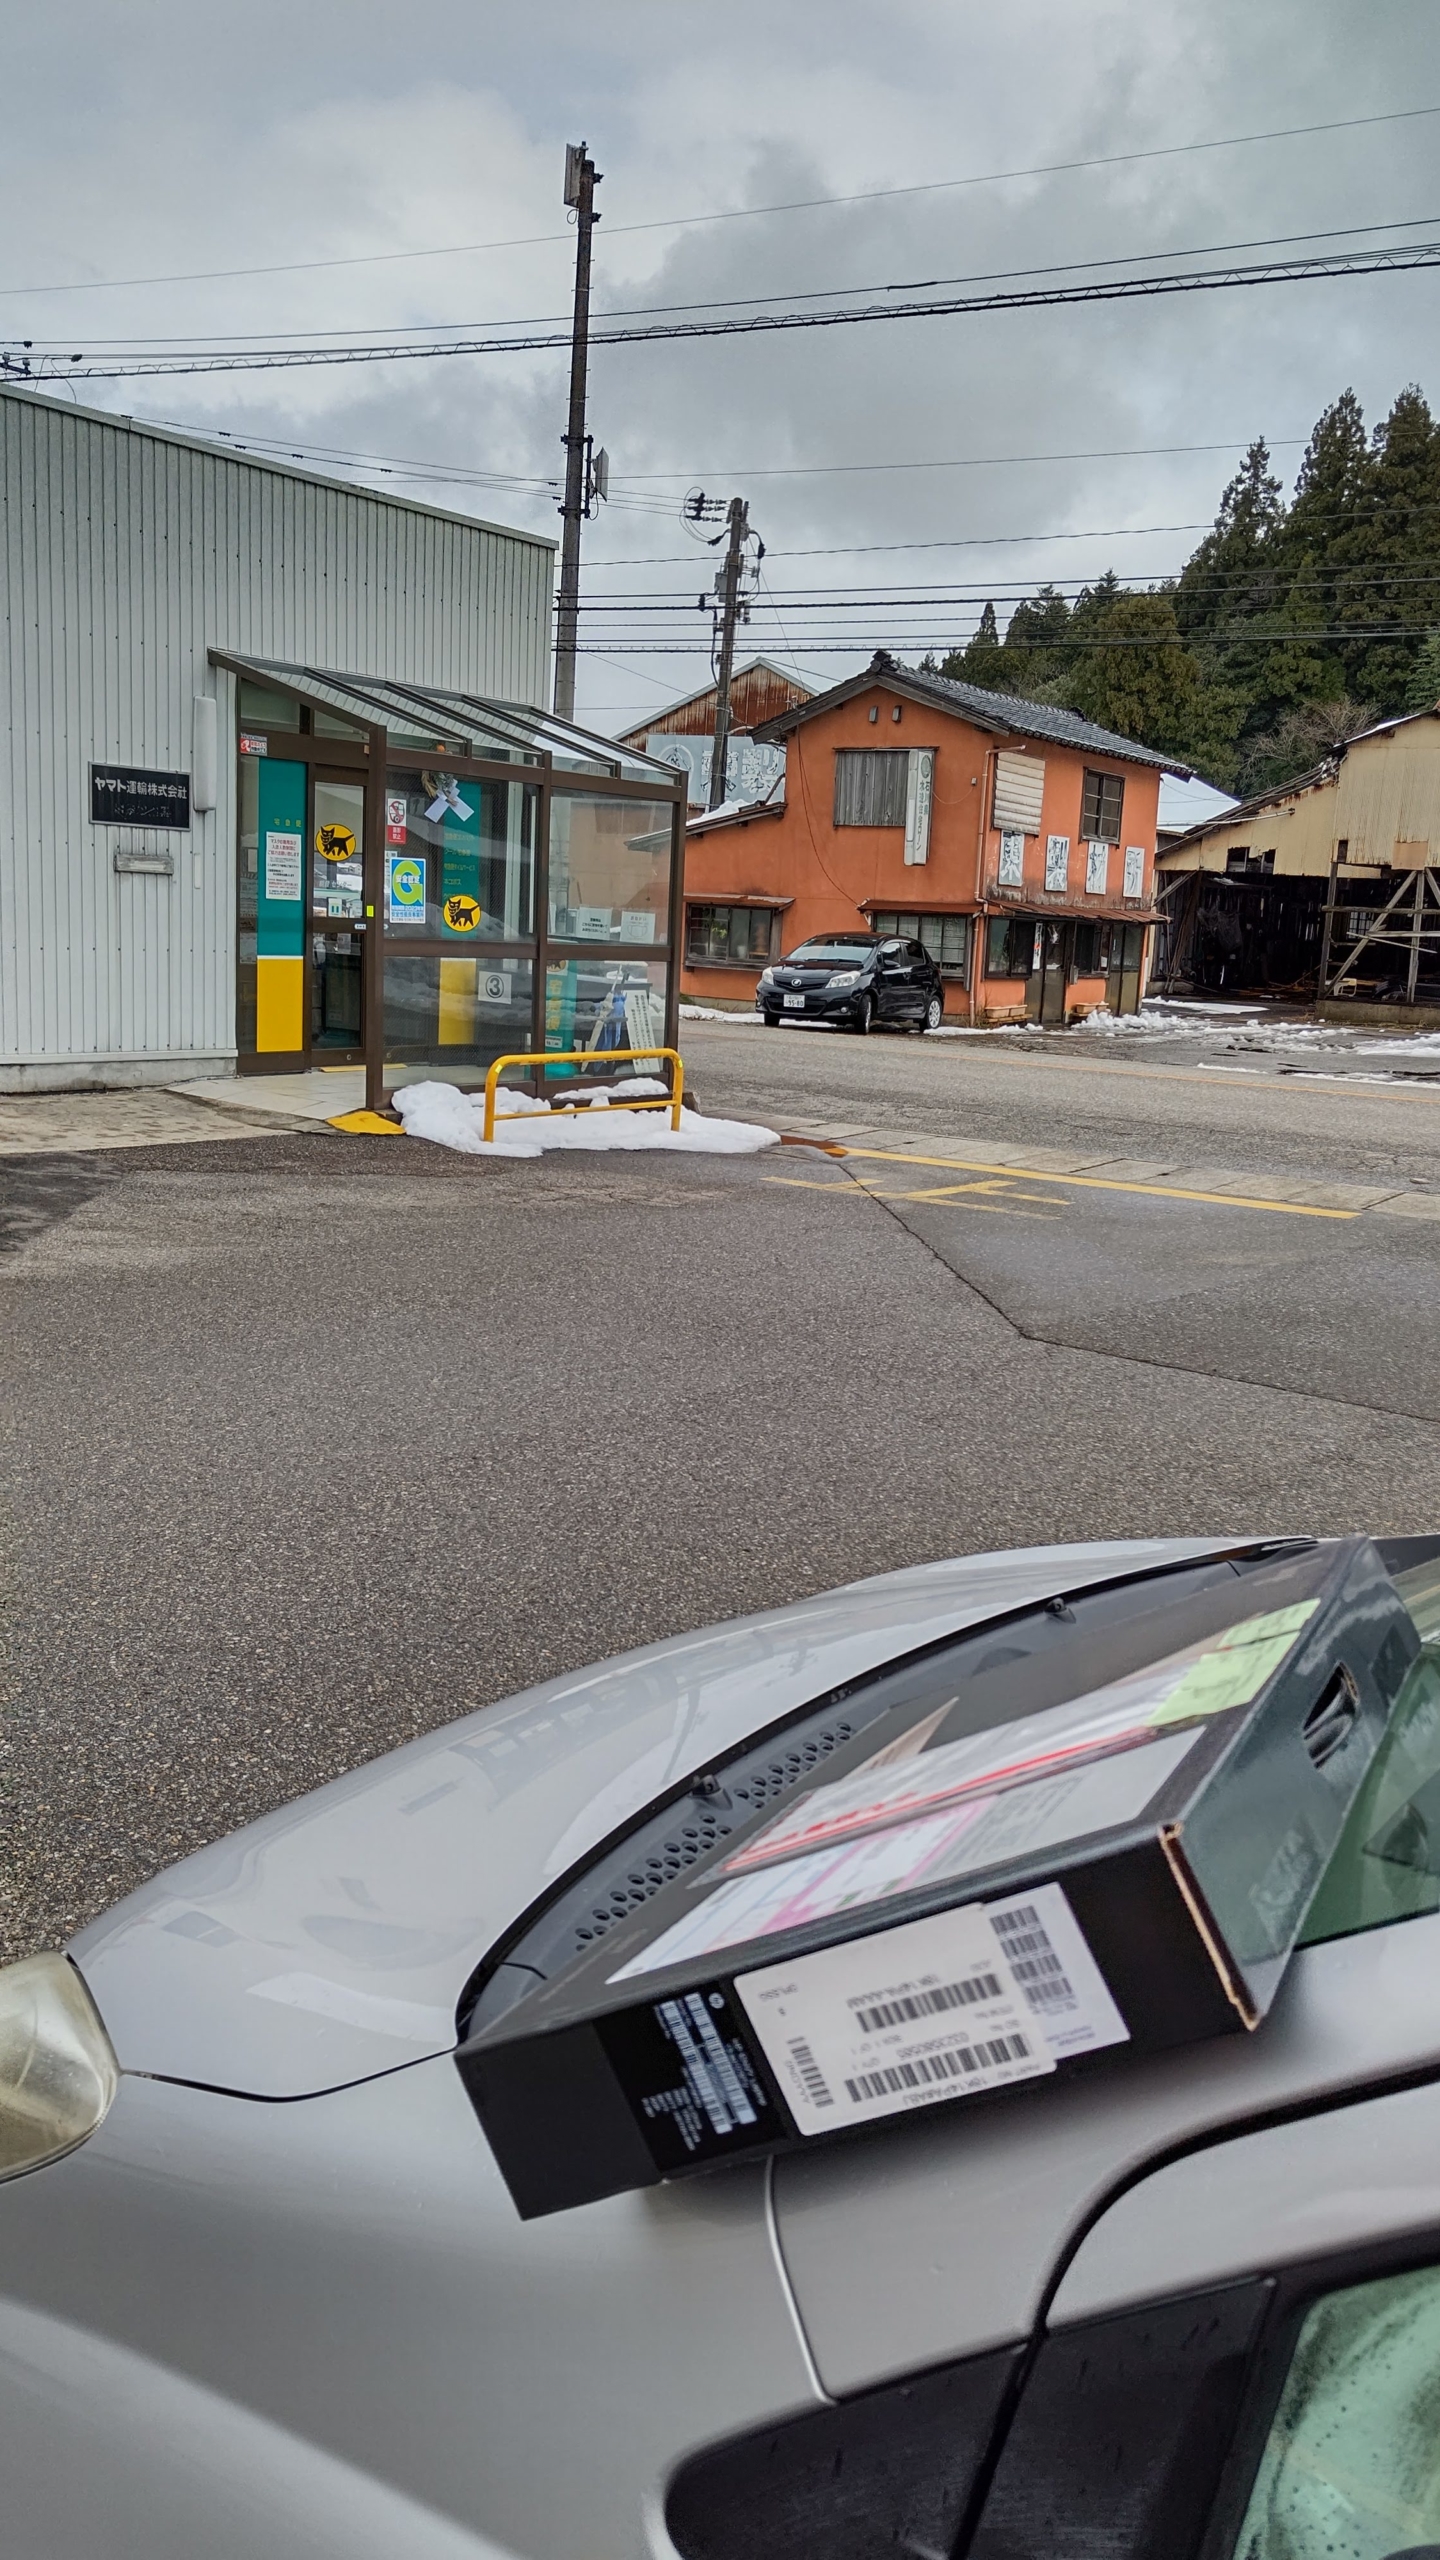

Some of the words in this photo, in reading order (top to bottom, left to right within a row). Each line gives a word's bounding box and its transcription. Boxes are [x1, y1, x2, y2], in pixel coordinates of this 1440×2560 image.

[95, 776, 188, 800] ヤマト運輸株式会社
